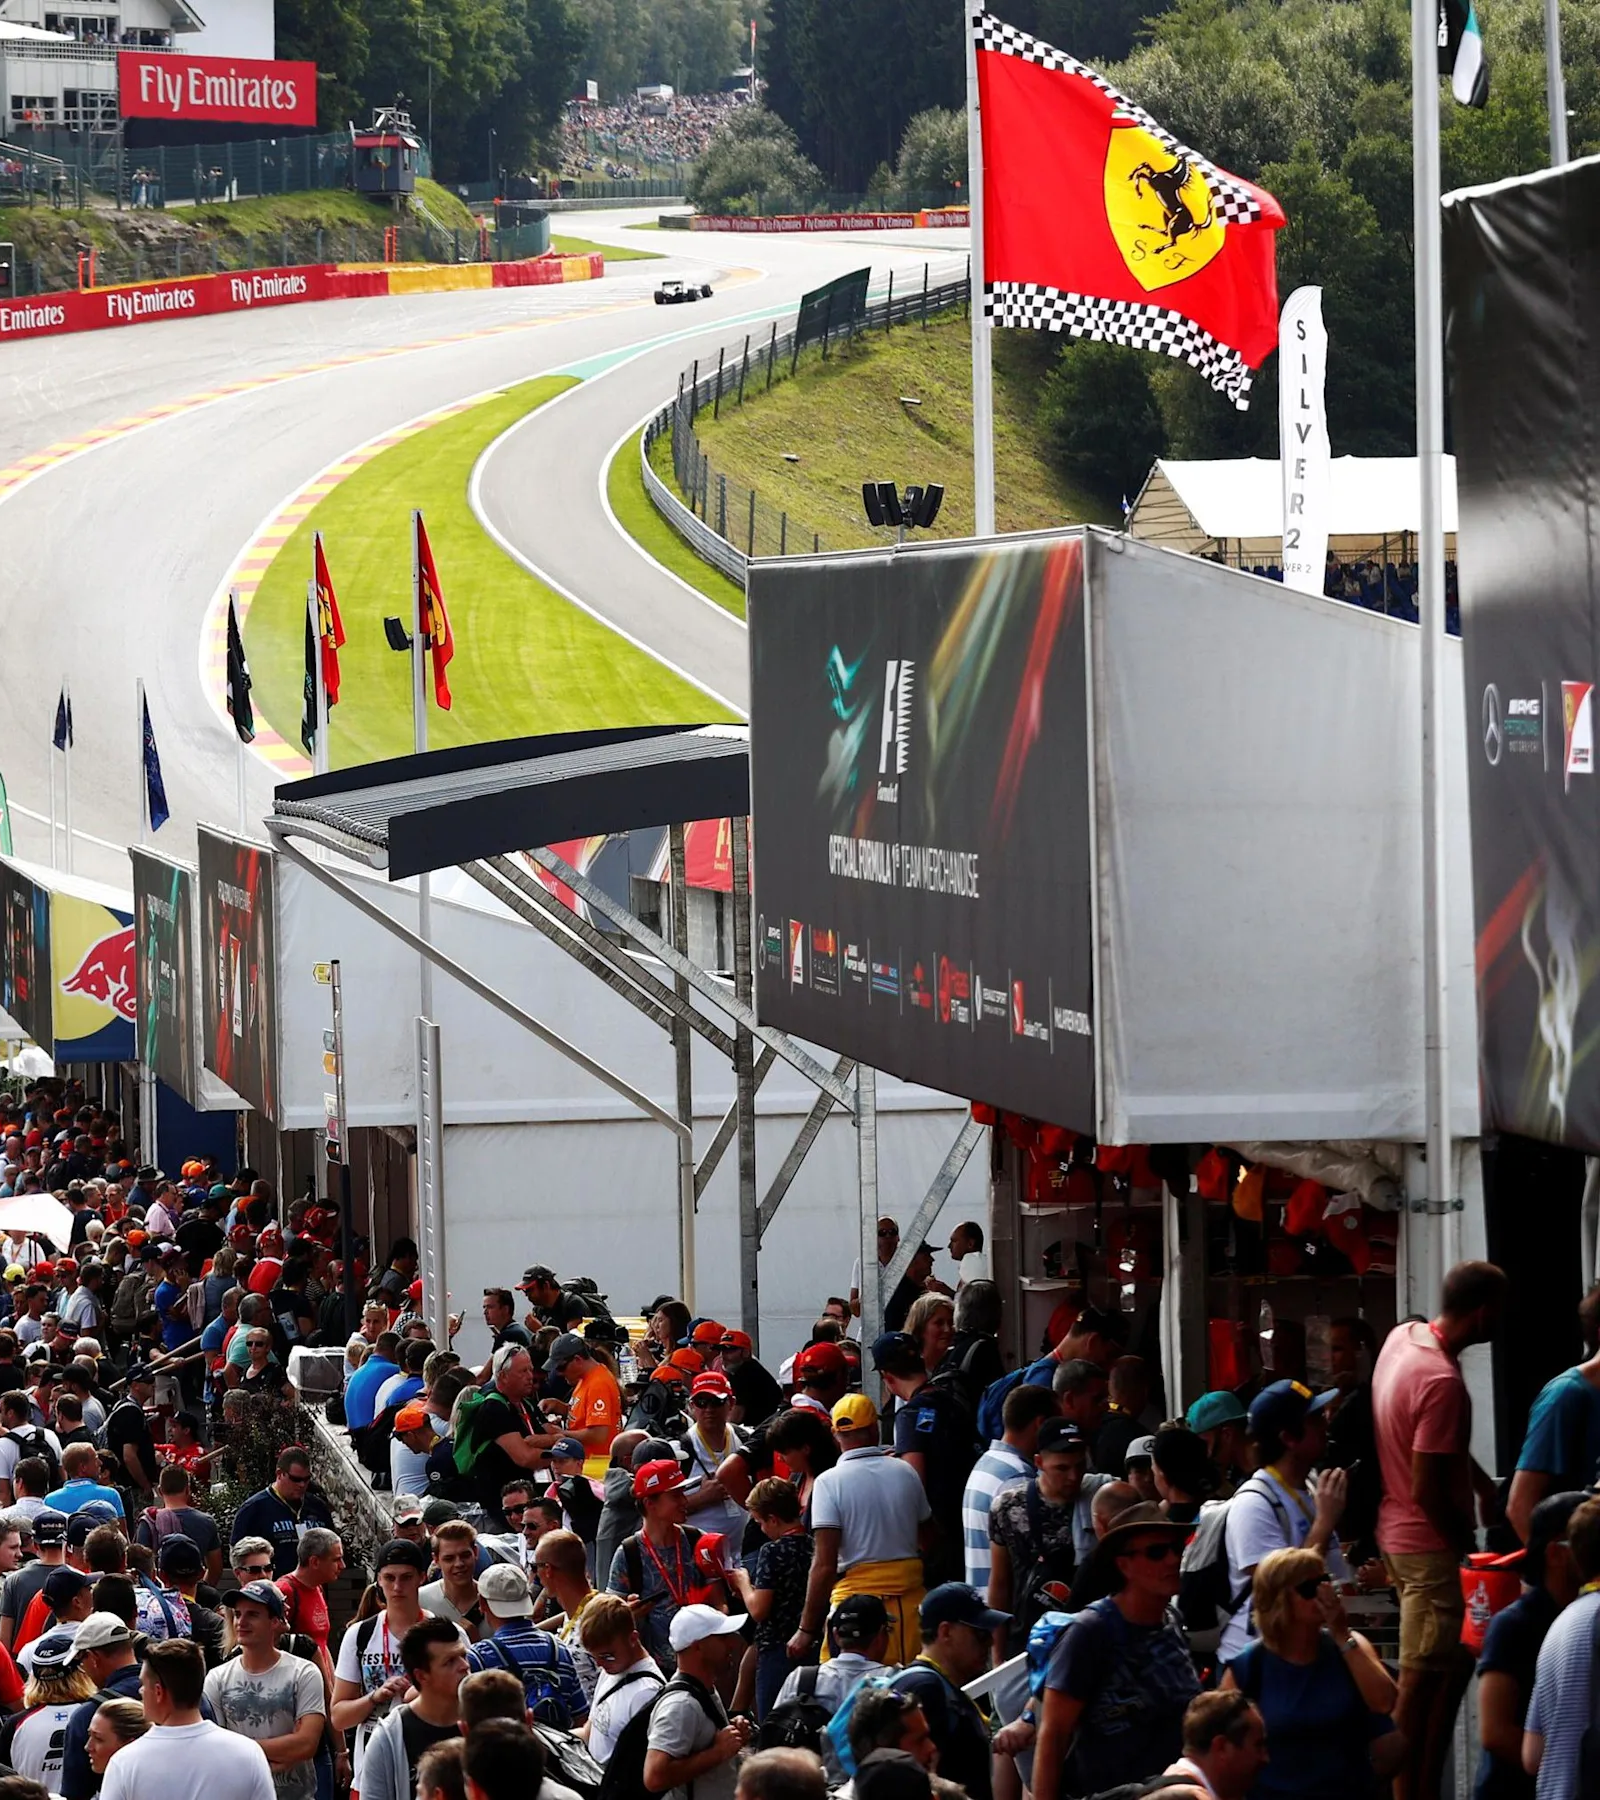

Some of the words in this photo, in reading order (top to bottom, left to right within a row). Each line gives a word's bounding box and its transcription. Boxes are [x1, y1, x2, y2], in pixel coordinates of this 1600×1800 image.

[139, 65, 182, 112] Fly
[187, 67, 297, 110] Emirates
[1130, 239, 1147, 261] S
[108, 293, 133, 320] Fly
[134, 287, 196, 314] Emirates
[231, 279, 252, 304] Fly
[253, 272, 307, 298] Emirates
[0, 303, 65, 331] Emirates
[1289, 319, 1312, 515] SILVER
[1286, 528, 1301, 550] 2
[829, 834, 858, 880] OFFICIAL
[858, 838, 891, 886] FORMULA
[901, 845, 921, 888] TEAM
[921, 847, 979, 899] MERCHANDISE
